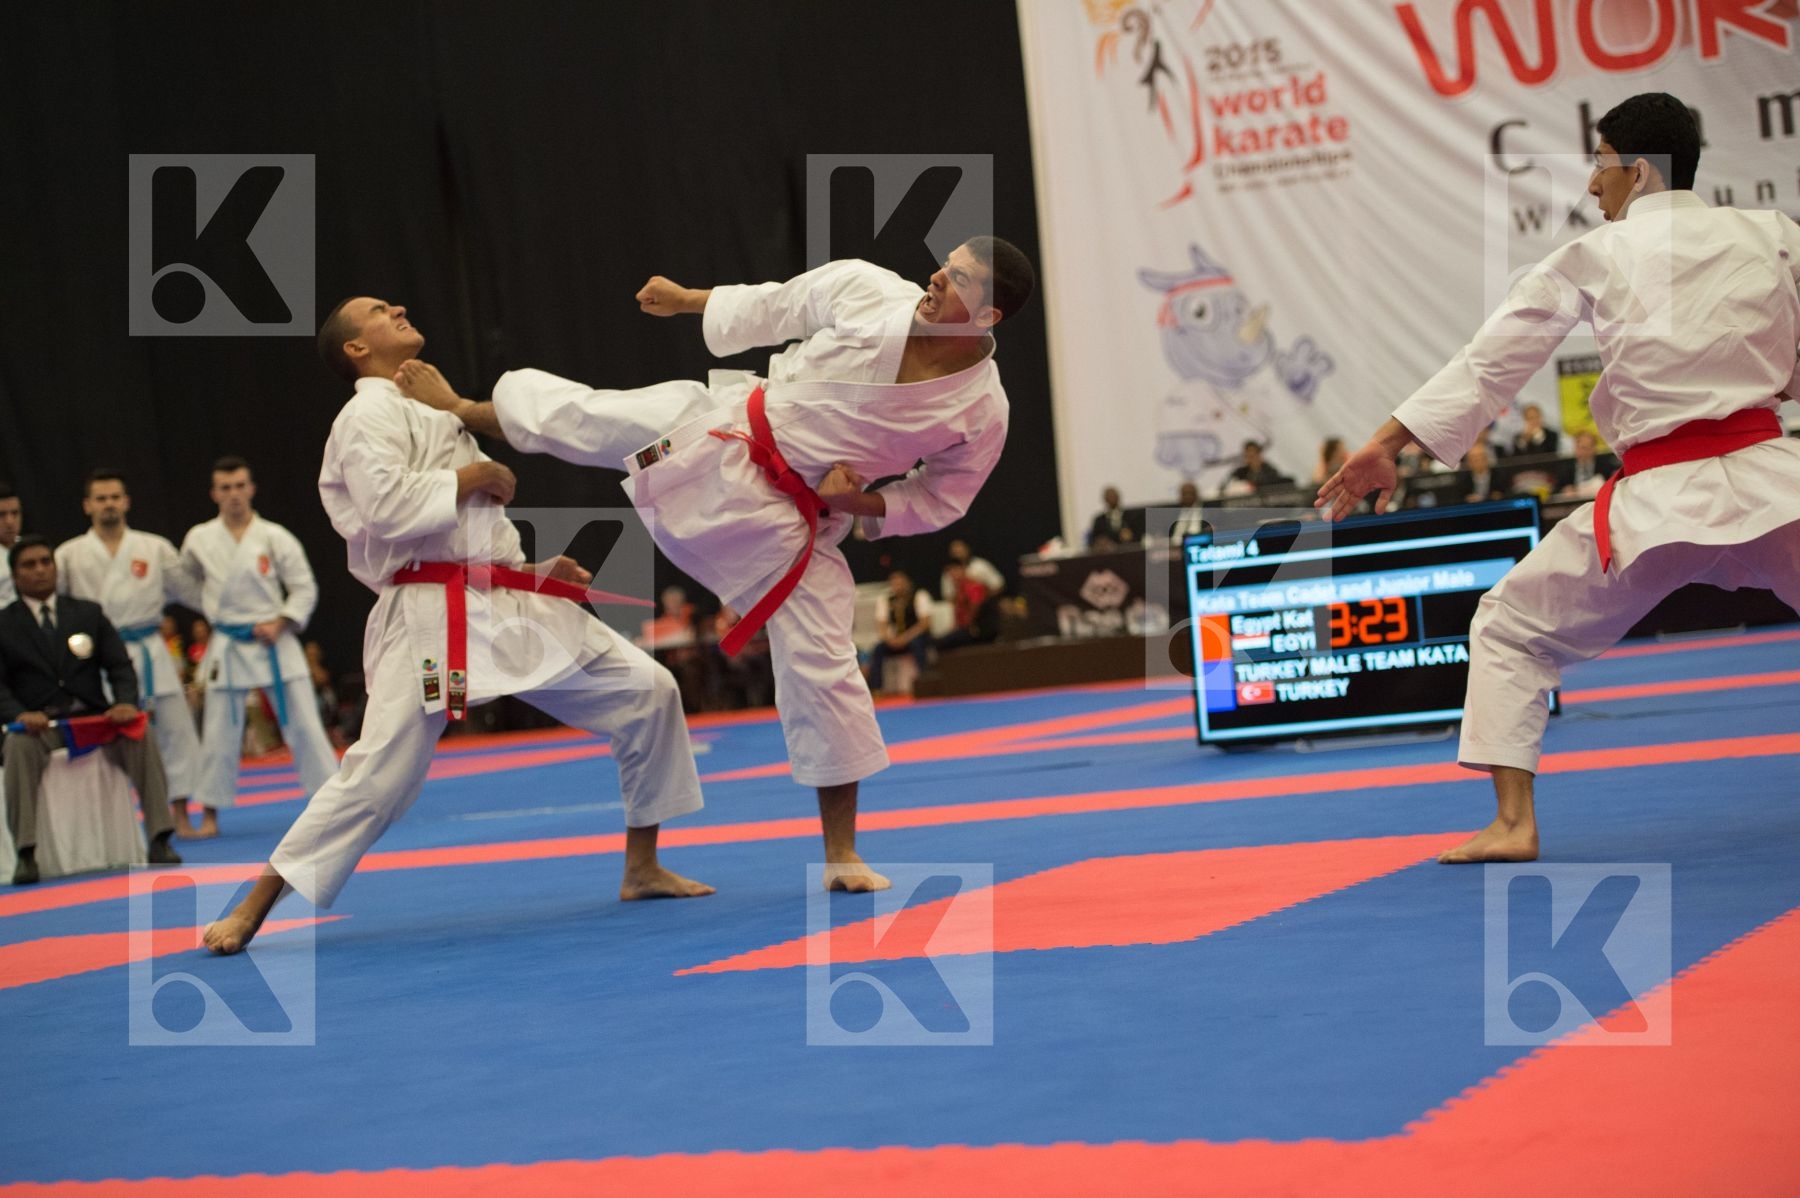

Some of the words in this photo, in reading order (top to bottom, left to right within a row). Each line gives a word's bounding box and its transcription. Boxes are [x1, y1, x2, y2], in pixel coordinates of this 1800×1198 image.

[1205, 38, 1282, 73] 2015
[1210, 72, 1328, 119] world
[1213, 115, 1349, 157] karate
[1189, 541, 1243, 563] Tatami
[1246, 542, 1259, 558] 4
[1198, 591, 1236, 613] Kata
[1240, 588, 1283, 610] Team
[1286, 582, 1338, 604] Cadet
[1341, 579, 1375, 600] and
[1378, 572, 1430, 597] Junior
[1432, 570, 1475, 589] Male
[1231, 611, 1280, 635] Egypt
[1328, 595, 1409, 647] 3:23
[1235, 661, 1308, 683] TURKEY
[1310, 656, 1361, 678] MALE
[1365, 649, 1414, 671] TEAM
[1418, 643, 1469, 666] KATA
[1277, 679, 1350, 702] TURKEY
